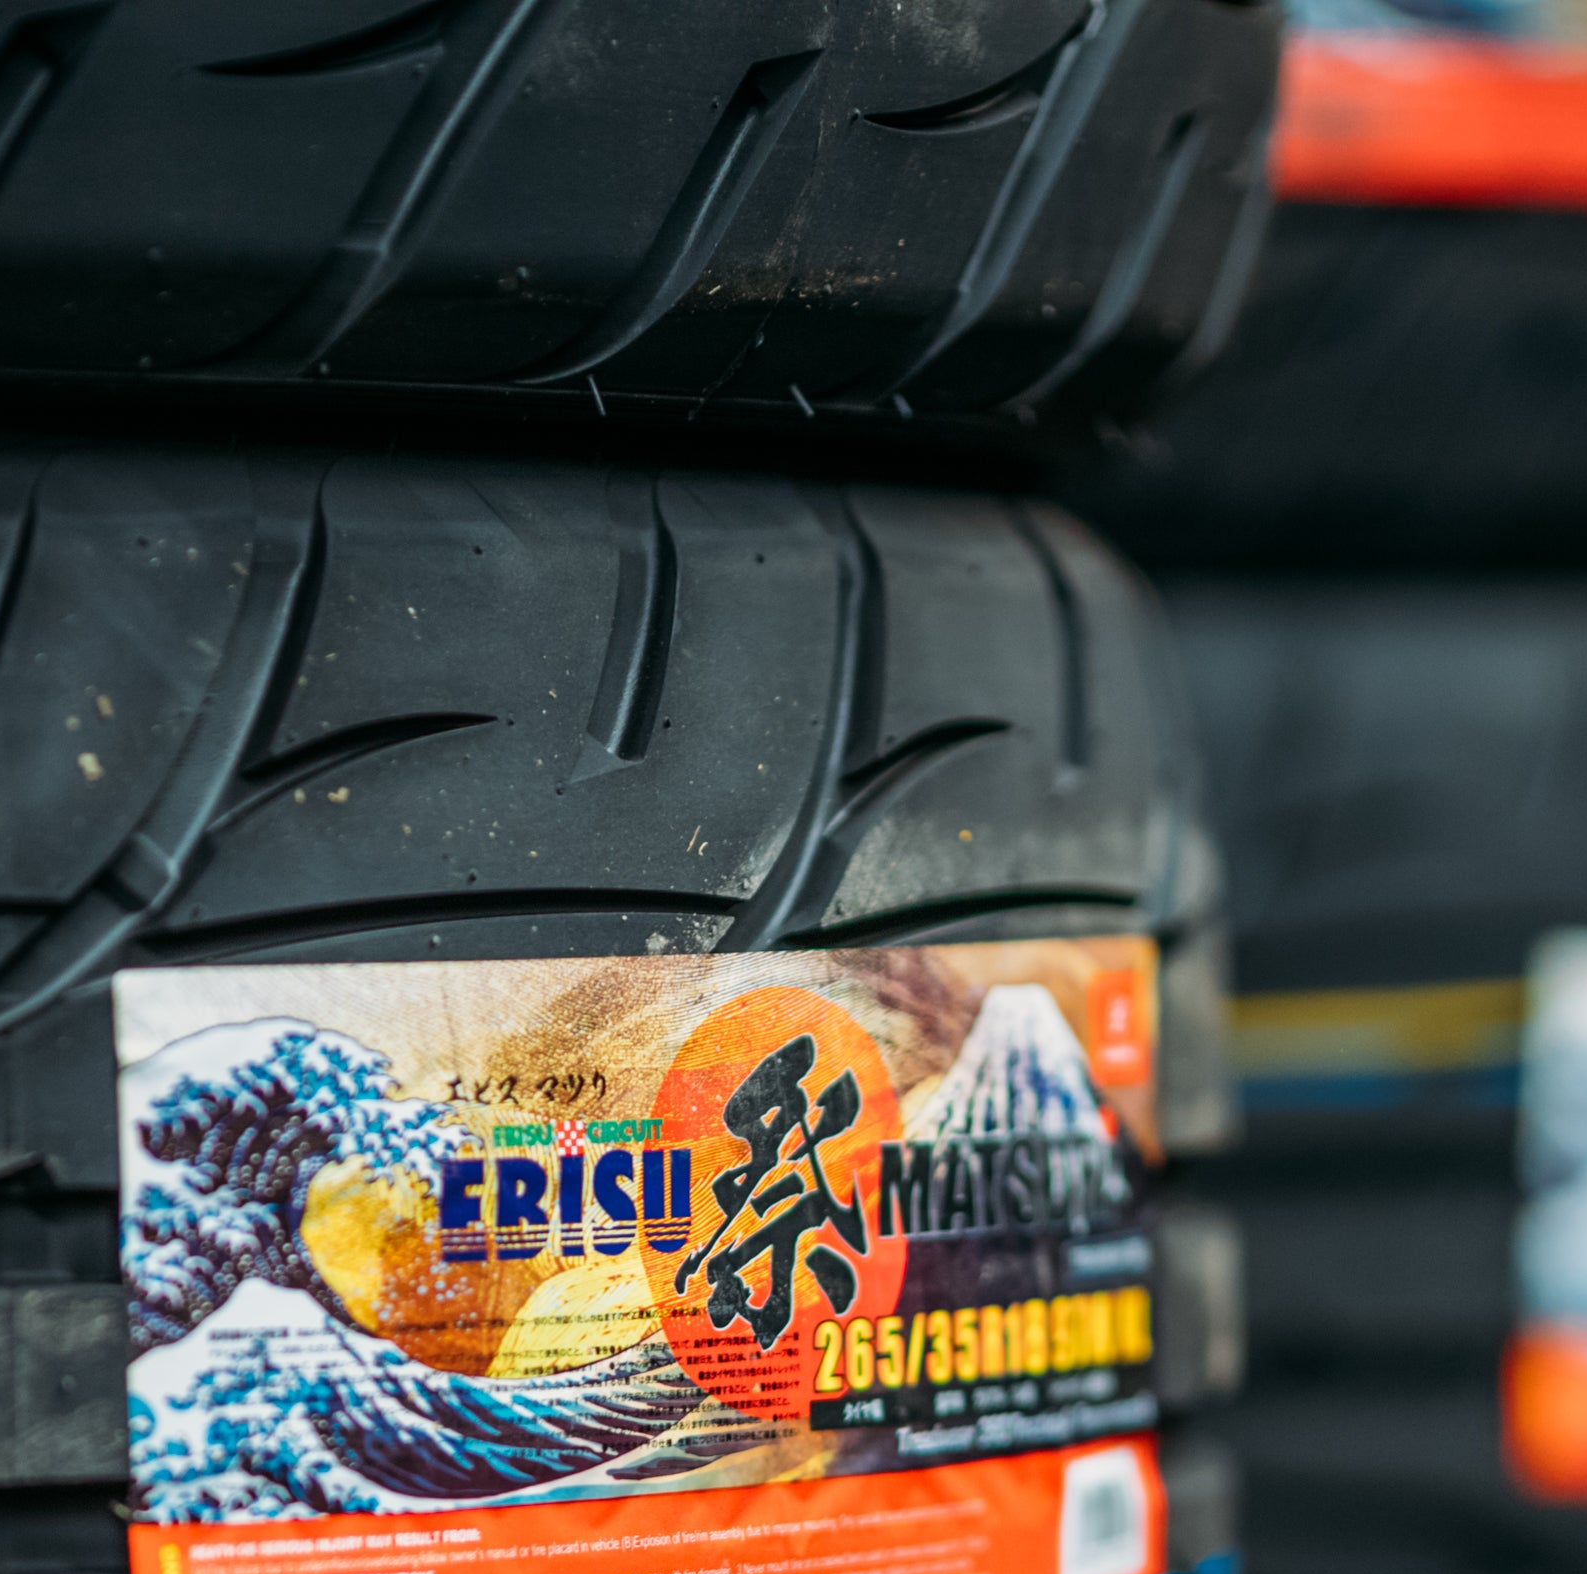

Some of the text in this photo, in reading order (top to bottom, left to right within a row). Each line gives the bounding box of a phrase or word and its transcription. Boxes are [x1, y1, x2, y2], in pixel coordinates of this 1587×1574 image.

[448, 1070, 607, 1104] エビス マツリ
[587, 1118, 662, 1143] CIRCUIT
[441, 1149, 691, 1262] EBISU
[674, 1033, 869, 1351] 祭
[395, 1529, 440, 1546] RESULT
[442, 1527, 481, 1544] FROM:
[485, 1544, 517, 1558] manual
[519, 1546, 529, 1556] or
[531, 1542, 546, 1555] tire
[547, 1539, 578, 1557] placard
[579, 1538, 589, 1551] in
[672, 1531, 680, 1544] of
[709, 1525, 745, 1540] assembly
[746, 1524, 760, 1537] due
